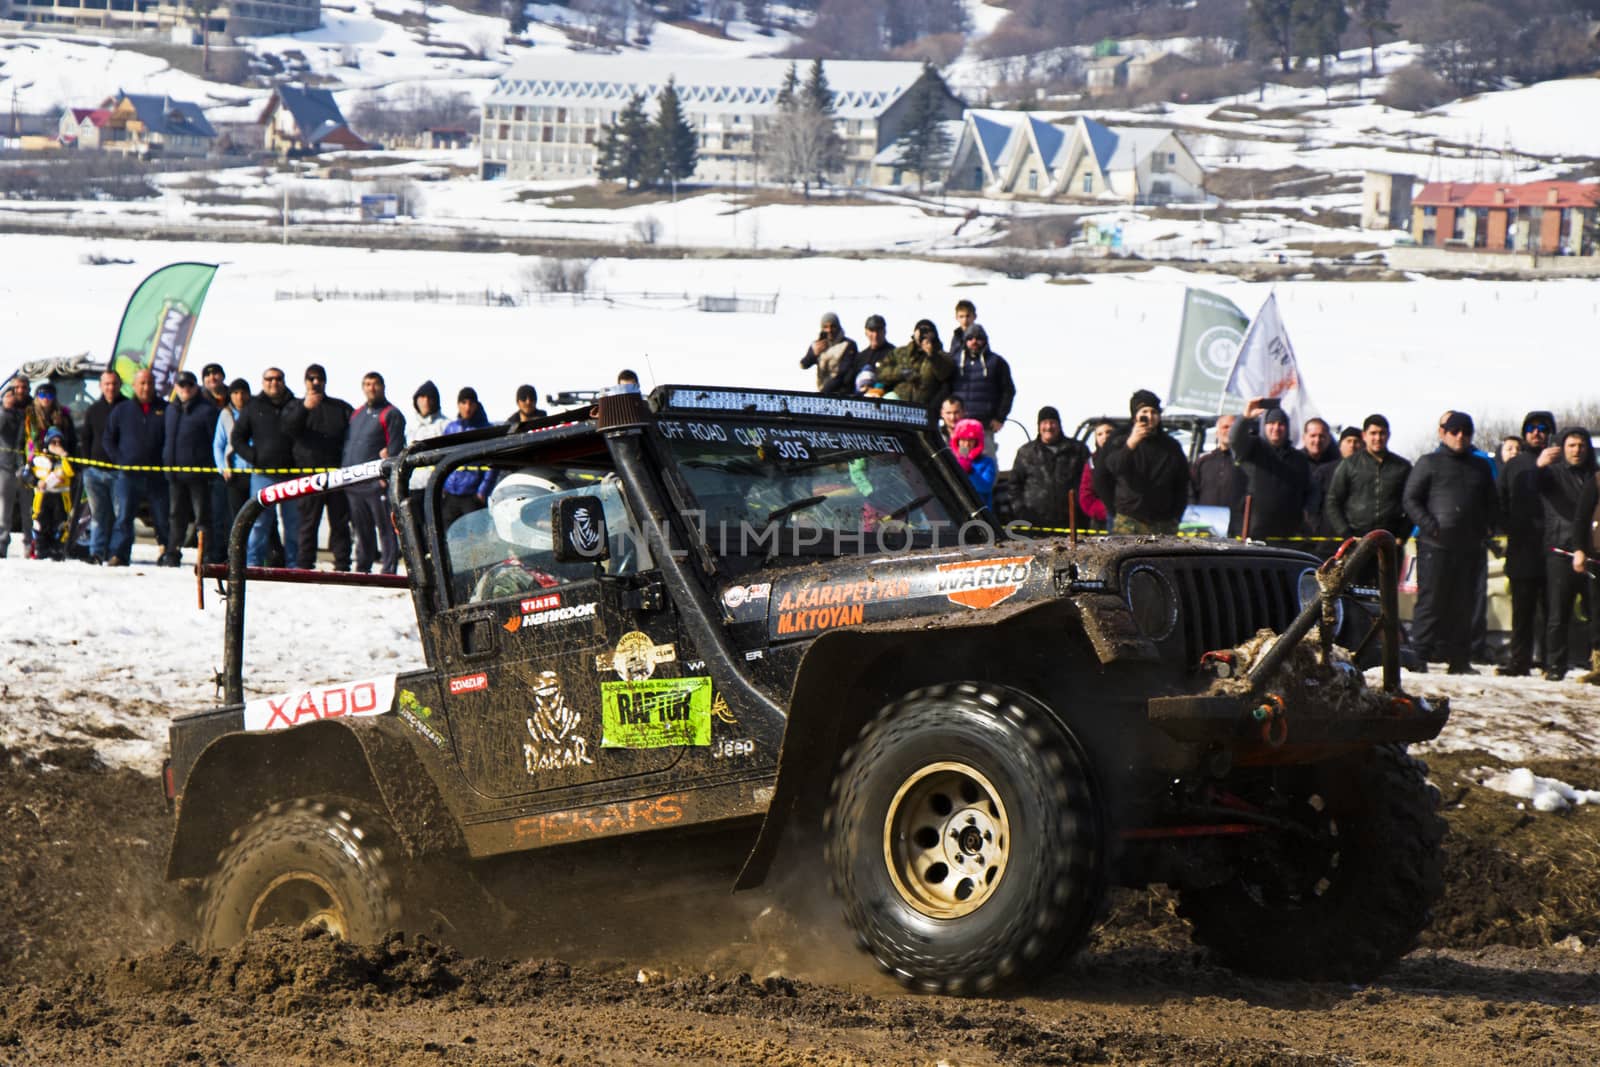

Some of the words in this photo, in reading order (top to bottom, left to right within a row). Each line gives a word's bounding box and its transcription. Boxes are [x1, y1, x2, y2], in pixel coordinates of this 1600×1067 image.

[657, 420, 683, 439] OFF
[687, 422, 728, 441] ROAD
[773, 440, 809, 460] 305
[777, 603, 864, 634] M.KTOYAN
[265, 682, 377, 730] XADO
[617, 689, 692, 725] RAPTOR
[523, 734, 594, 775] DAKAR
[513, 794, 683, 847] FISKARS
